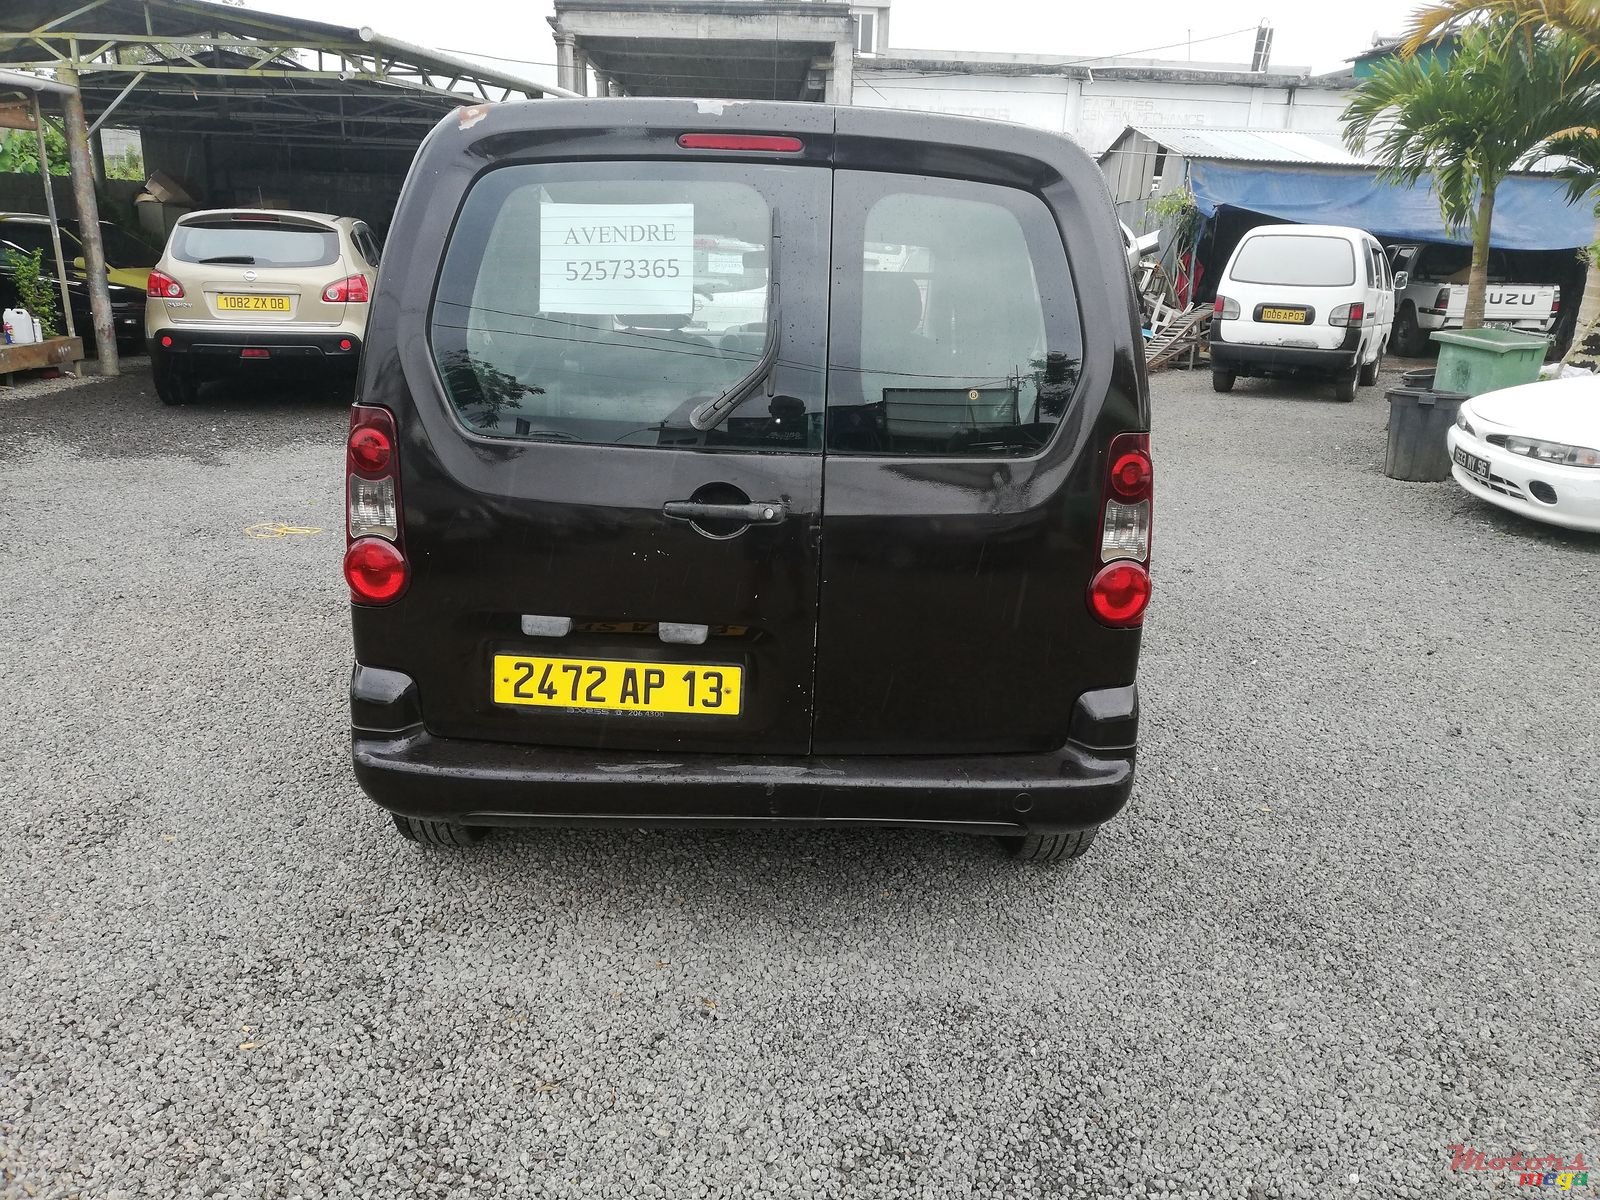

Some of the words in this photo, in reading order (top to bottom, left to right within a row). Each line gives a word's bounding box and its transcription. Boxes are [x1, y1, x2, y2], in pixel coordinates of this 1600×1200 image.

[565, 259, 680, 281] 52573365
[223, 297, 250, 308] 1082
[254, 298, 267, 309] ZX
[270, 298, 284, 309] 08
[1484, 293, 1536, 305] UZU
[1476, 460, 1487, 476] 96
[513, 662, 607, 703] 2472
[619, 667, 664, 705] AP
[682, 670, 723, 708] 13
